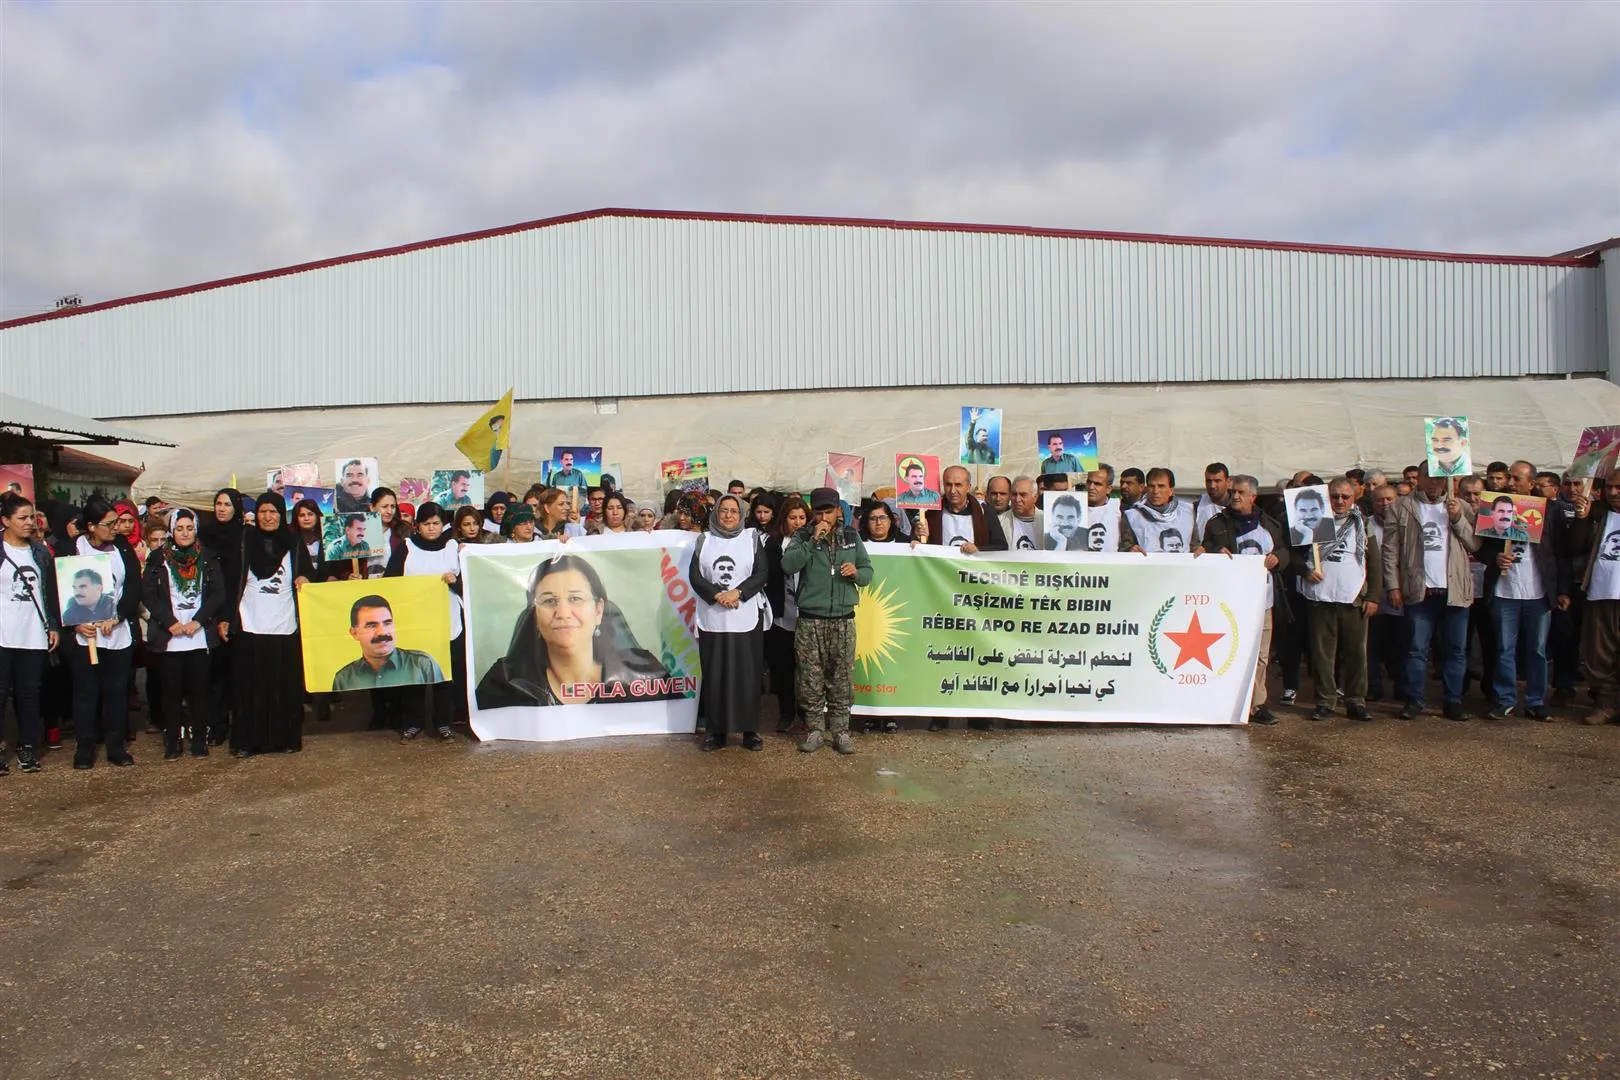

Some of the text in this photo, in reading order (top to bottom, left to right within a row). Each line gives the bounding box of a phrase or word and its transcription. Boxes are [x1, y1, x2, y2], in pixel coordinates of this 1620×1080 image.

[958, 570, 1110, 591] TECRÎDÊ BIŞKÎNIN
[953, 592, 1112, 612] FAŞÎZMÊ TÊK BIBIN
[1184, 594, 1210, 605] PYD
[922, 613, 1139, 636] RÊBER APO RE AZAD BIJÎN
[927, 644, 974, 664] الفاشية
[977, 648, 1004, 666] على
[1047, 649, 1086, 669] العزلة
[1090, 650, 1132, 671] لنحطم
[561, 676, 698, 699] LEYLA GUVEN
[852, 684, 897, 694] eya Star
[962, 674, 998, 692] القائد
[1001, 680, 1020, 696] مع
[1065, 678, 1092, 698] نحيا
[1178, 673, 1207, 685] 2003
[1095, 679, 1116, 702] كي
